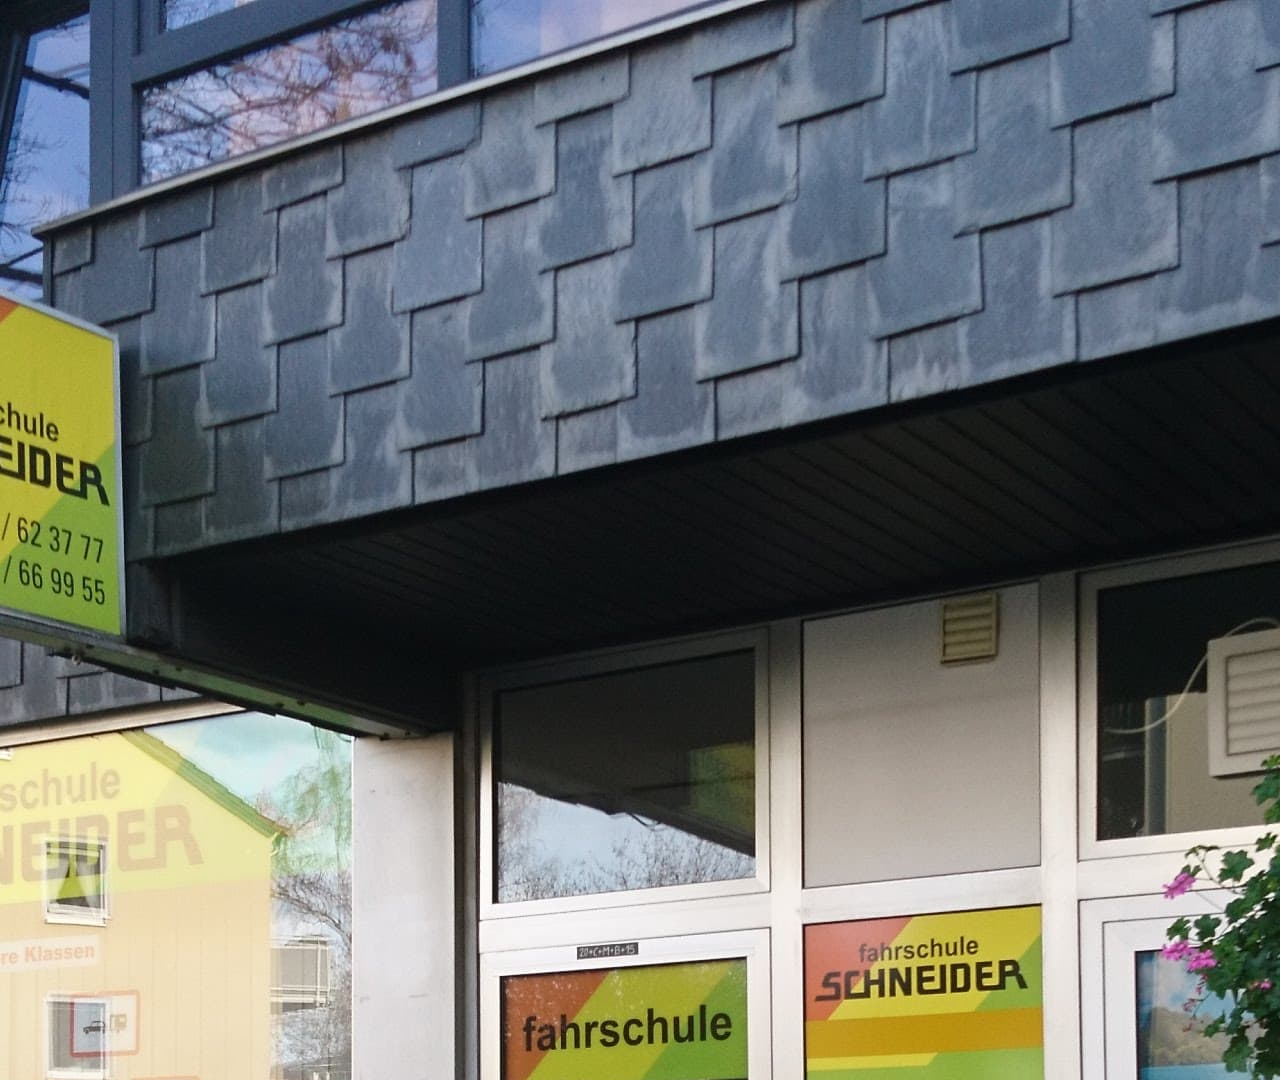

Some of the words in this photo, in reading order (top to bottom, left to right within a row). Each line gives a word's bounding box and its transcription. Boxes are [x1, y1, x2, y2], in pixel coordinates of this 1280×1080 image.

[2, 512, 12, 542] /
[18, 517, 42, 548] 62
[49, 525, 74, 556] 37
[81, 533, 105, 564] 77
[3, 555, 13, 585] /
[19, 559, 44, 589] 66
[51, 567, 75, 598] 99
[82, 575, 106, 606] 55
[24, 941, 95, 965] Klassen
[858, 936, 979, 963] fahrschule
[814, 958, 1028, 1002] SCHNEIDER
[522, 1004, 733, 1054] fahrschule
